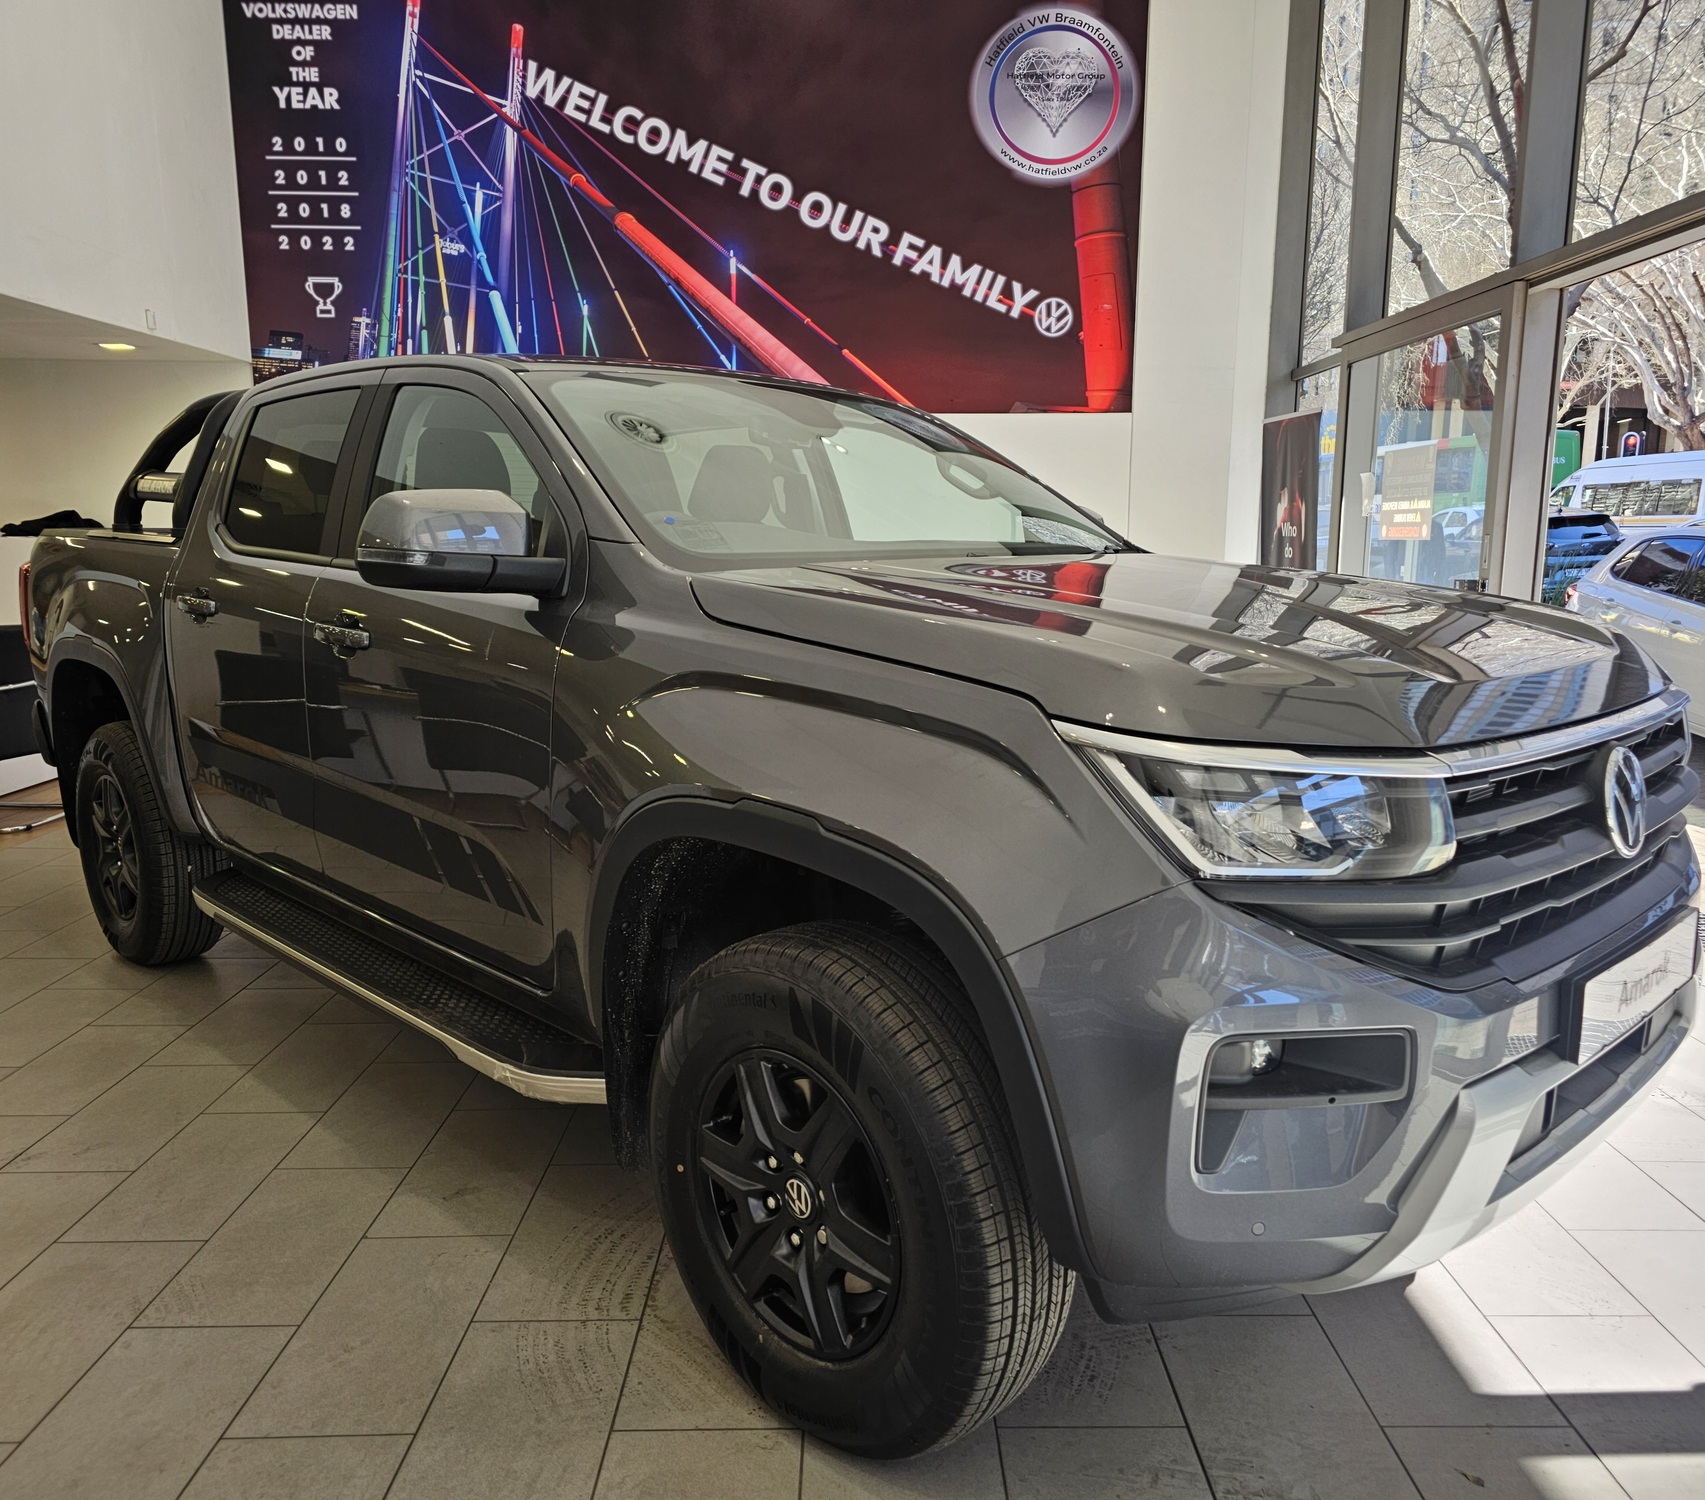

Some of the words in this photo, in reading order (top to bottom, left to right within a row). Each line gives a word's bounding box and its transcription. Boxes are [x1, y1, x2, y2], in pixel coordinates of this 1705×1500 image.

[241, 2, 358, 20] VOLKSWAGEN
[271, 24, 332, 41] DEALER
[985, 23, 1026, 68] Hatfield
[1027, 13, 1050, 28] VW
[1055, 12, 1125, 70] Braamfontein
[291, 45, 315, 61] OF
[289, 66, 320, 82] THE
[1047, 72, 1075, 80] Motor
[1077, 72, 1106, 81] Group
[271, 86, 341, 110] YEAR
[271, 136, 347, 152] 2010
[1000, 146, 1108, 177] www.hatfieldvw.co.za
[274, 170, 349, 186] 2012
[525, 58, 735, 187] WELCOME
[738, 157, 793, 211] TO
[799, 191, 890, 258] OUR
[891, 231, 1041, 319] FAMILY
[276, 203, 352, 218] 2018
[278, 235, 355, 251] 2022
[1281, 522, 1298, 538] Who
[1284, 542, 1293, 559] do
